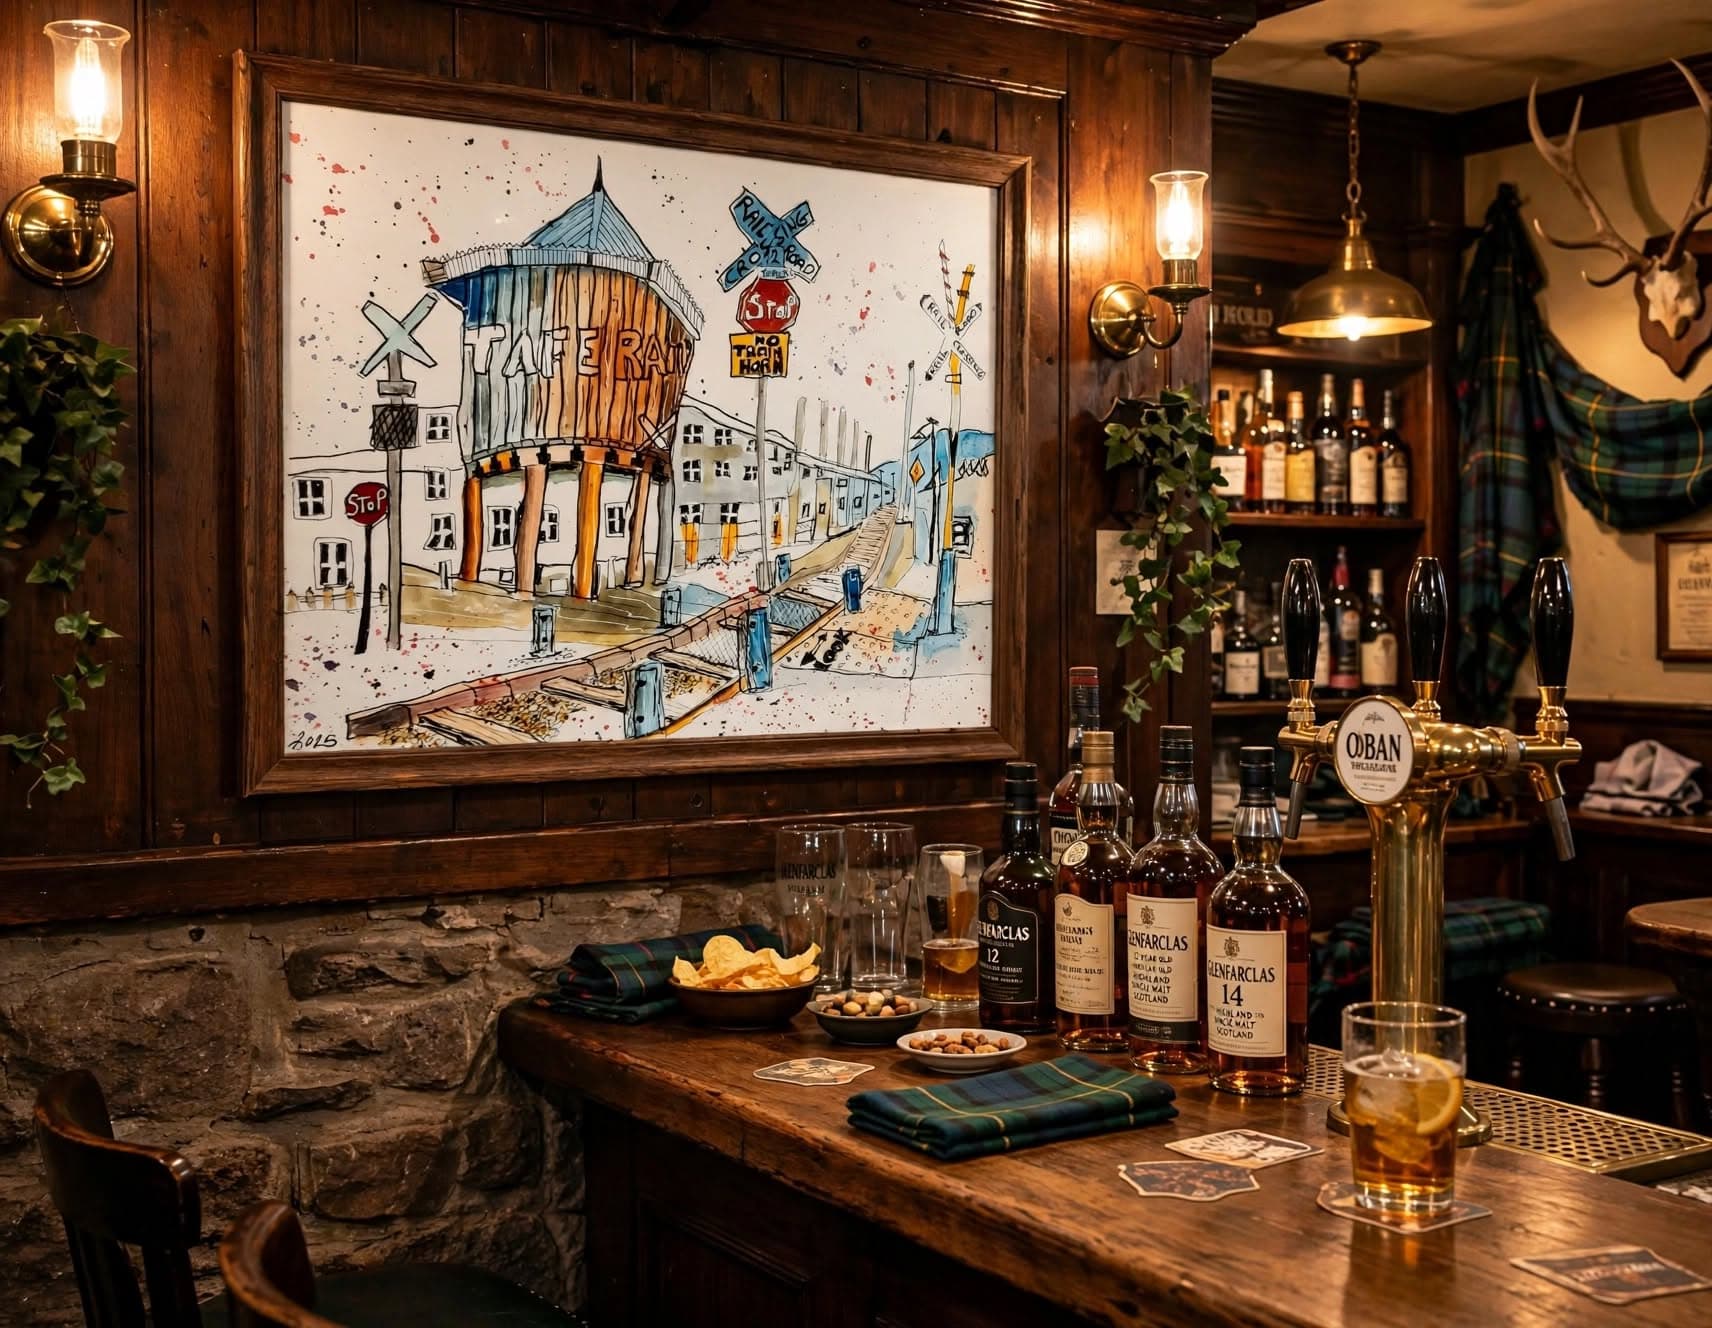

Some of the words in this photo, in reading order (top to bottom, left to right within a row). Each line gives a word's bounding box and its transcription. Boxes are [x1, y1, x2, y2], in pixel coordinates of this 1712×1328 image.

[755, 335, 780, 347] NO
[733, 344, 783, 359] TRAIN
[739, 358, 784, 375] HORN
[986, 948, 1000, 964] 12
[1222, 983, 1244, 1007] 14
